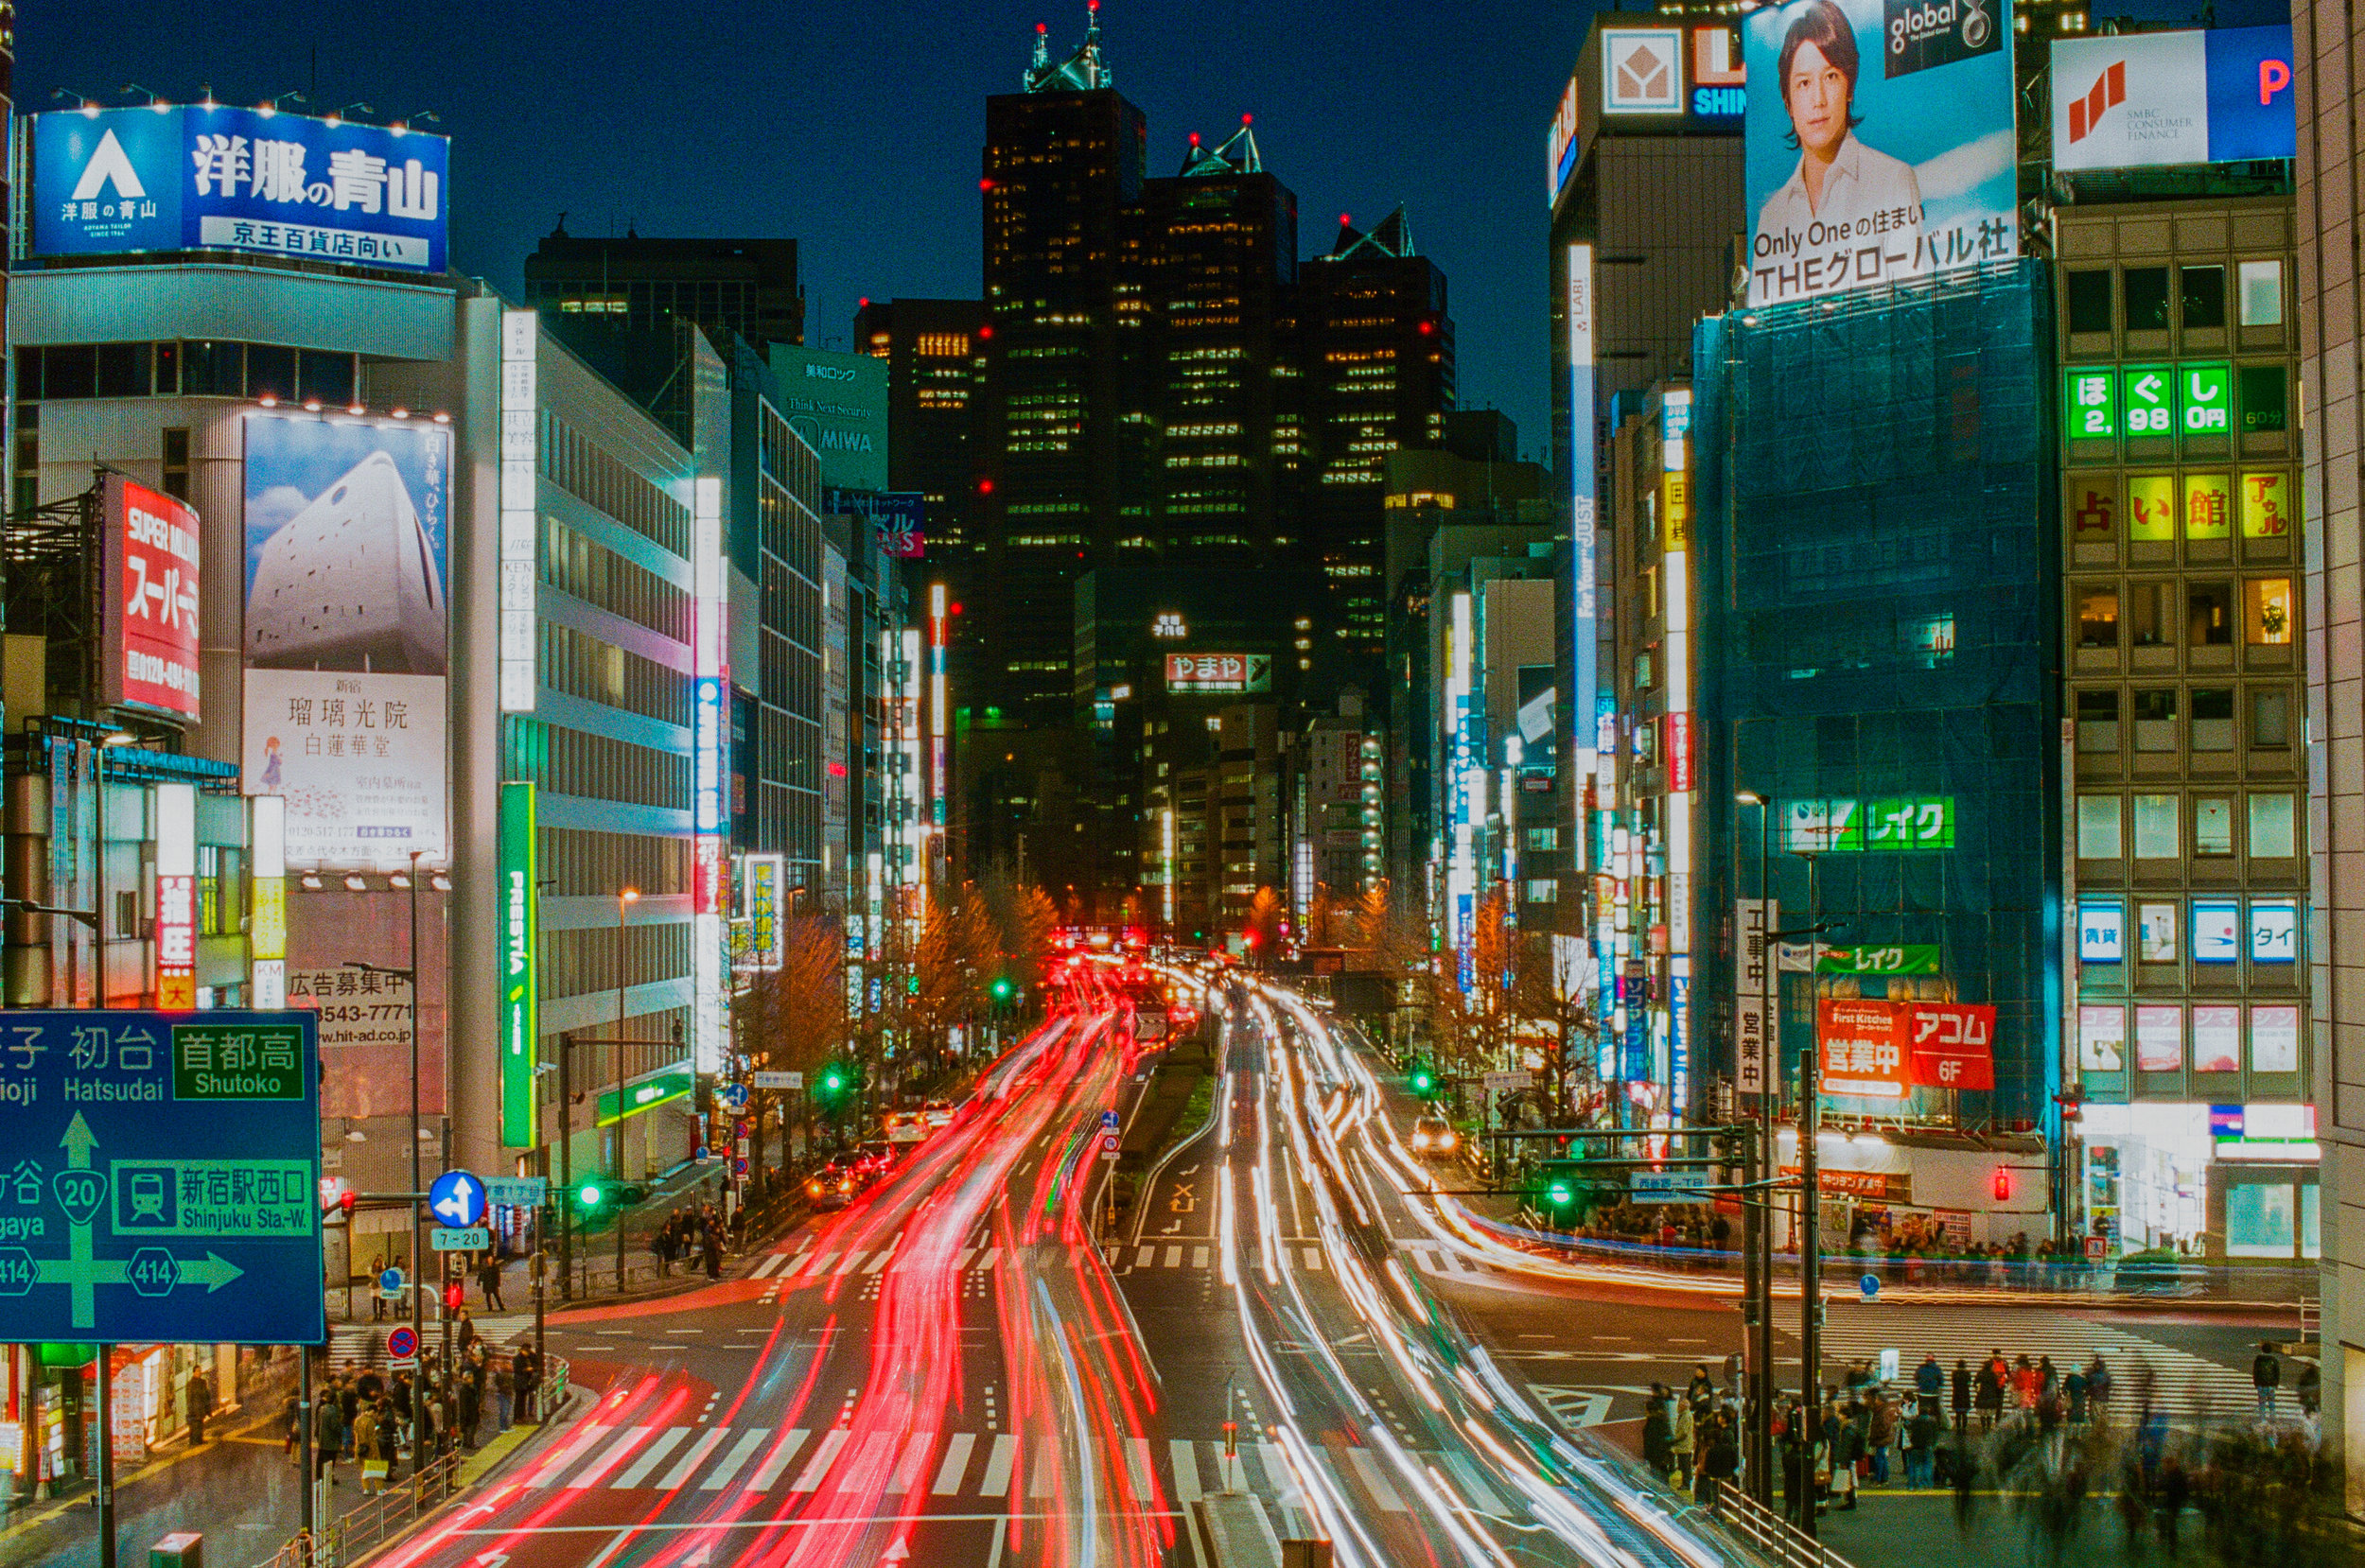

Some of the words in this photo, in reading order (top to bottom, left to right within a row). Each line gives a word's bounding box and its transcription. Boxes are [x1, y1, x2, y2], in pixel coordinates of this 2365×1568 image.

[1892, 0, 1956, 54] global
[2128, 109, 2159, 119] SMBC
[2128, 118, 2192, 131] CONSUMER
[2128, 129, 2179, 141] FINANCE
[192, 134, 438, 220] 洋服の青山
[61, 200, 156, 221] 洋服の青山
[234, 221, 404, 260] 京王百貨店向い
[1754, 227, 1802, 259] Only
[1808, 220, 1851, 247] One
[1855, 203, 1926, 236] の住まい
[1754, 217, 2009, 300] THEグローバル社
[1572, 279, 1585, 315] LABI
[806, 363, 855, 381] 美和ロック
[2078, 373, 2217, 403] ほぐし
[790, 397, 814, 410] Think
[816, 400, 834, 414] Next
[837, 404, 871, 419] Security
[820, 429, 872, 453] MIWA
[2076, 488, 2226, 533] 占い館
[128, 507, 168, 551] SUPER
[1175, 657, 1241, 678] やまや
[336, 679, 362, 694] 新宿
[289, 697, 408, 729] 瑠璃光院
[306, 733, 392, 758] 白蓮華堂
[1869, 804, 1944, 840] レイク
[2084, 928, 2118, 945] 賃貸
[2255, 927, 2293, 946] タイ
[1856, 948, 1903, 961] レイク
[289, 970, 405, 997] 広告募集中
[1833, 1012, 1854, 1023] First
[1856, 1014, 1893, 1025] Kitchen
[1914, 1012, 1987, 1045] アコム
[0, 1026, 47, 1070] 子
[69, 1025, 156, 1070] 初台
[181, 1033, 295, 1071] 首都高
[319, 1028, 412, 1043] w.hit-ad.co.jp
[1743, 1011, 1761, 1088] 営業中
[1827, 1037, 1900, 1075] 営業中
[1938, 1060, 1962, 1082] 6F
[64, 1078, 163, 1101] Hatsudai
[195, 1073, 282, 1094] Shutoko
[64, 1179, 95, 1207] 20
[182, 1169, 305, 1206] 新宿駅西口
[184, 1209, 251, 1231] Shinjuku
[257, 1209, 307, 1228] Sta.-W.
[440, 1233, 481, 1246] 7-20
[135, 1260, 171, 1284] 414
